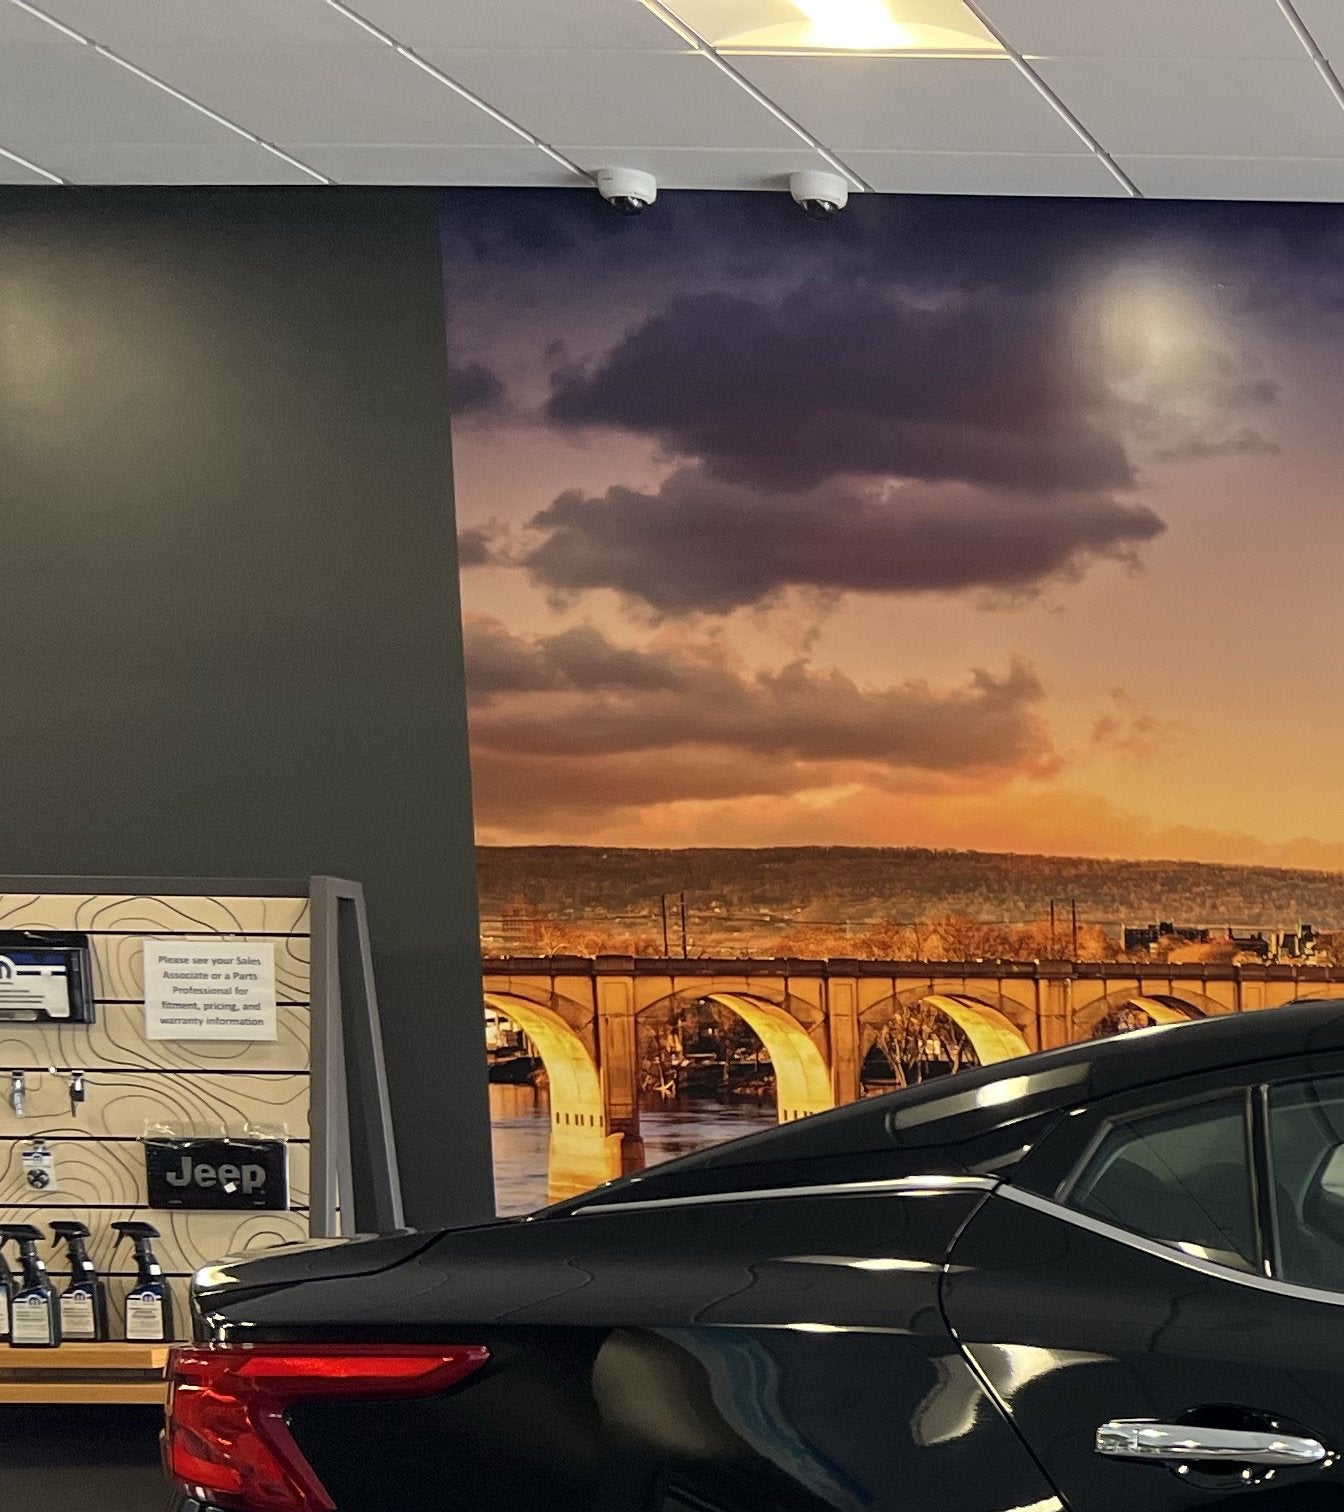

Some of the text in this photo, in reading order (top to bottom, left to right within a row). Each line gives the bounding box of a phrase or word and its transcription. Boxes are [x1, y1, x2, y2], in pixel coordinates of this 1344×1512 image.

[158, 955, 262, 966] Please see your Sales
[162, 970, 209, 980] Associate
[211, 972, 222, 980] or
[232, 971, 258, 981] Parts
[172, 986, 249, 995] Professional for
[161, 1001, 261, 1012] fitment, pricing, and
[160, 1017, 264, 1026] warranty information
[166, 1156, 267, 1194] Jeep
